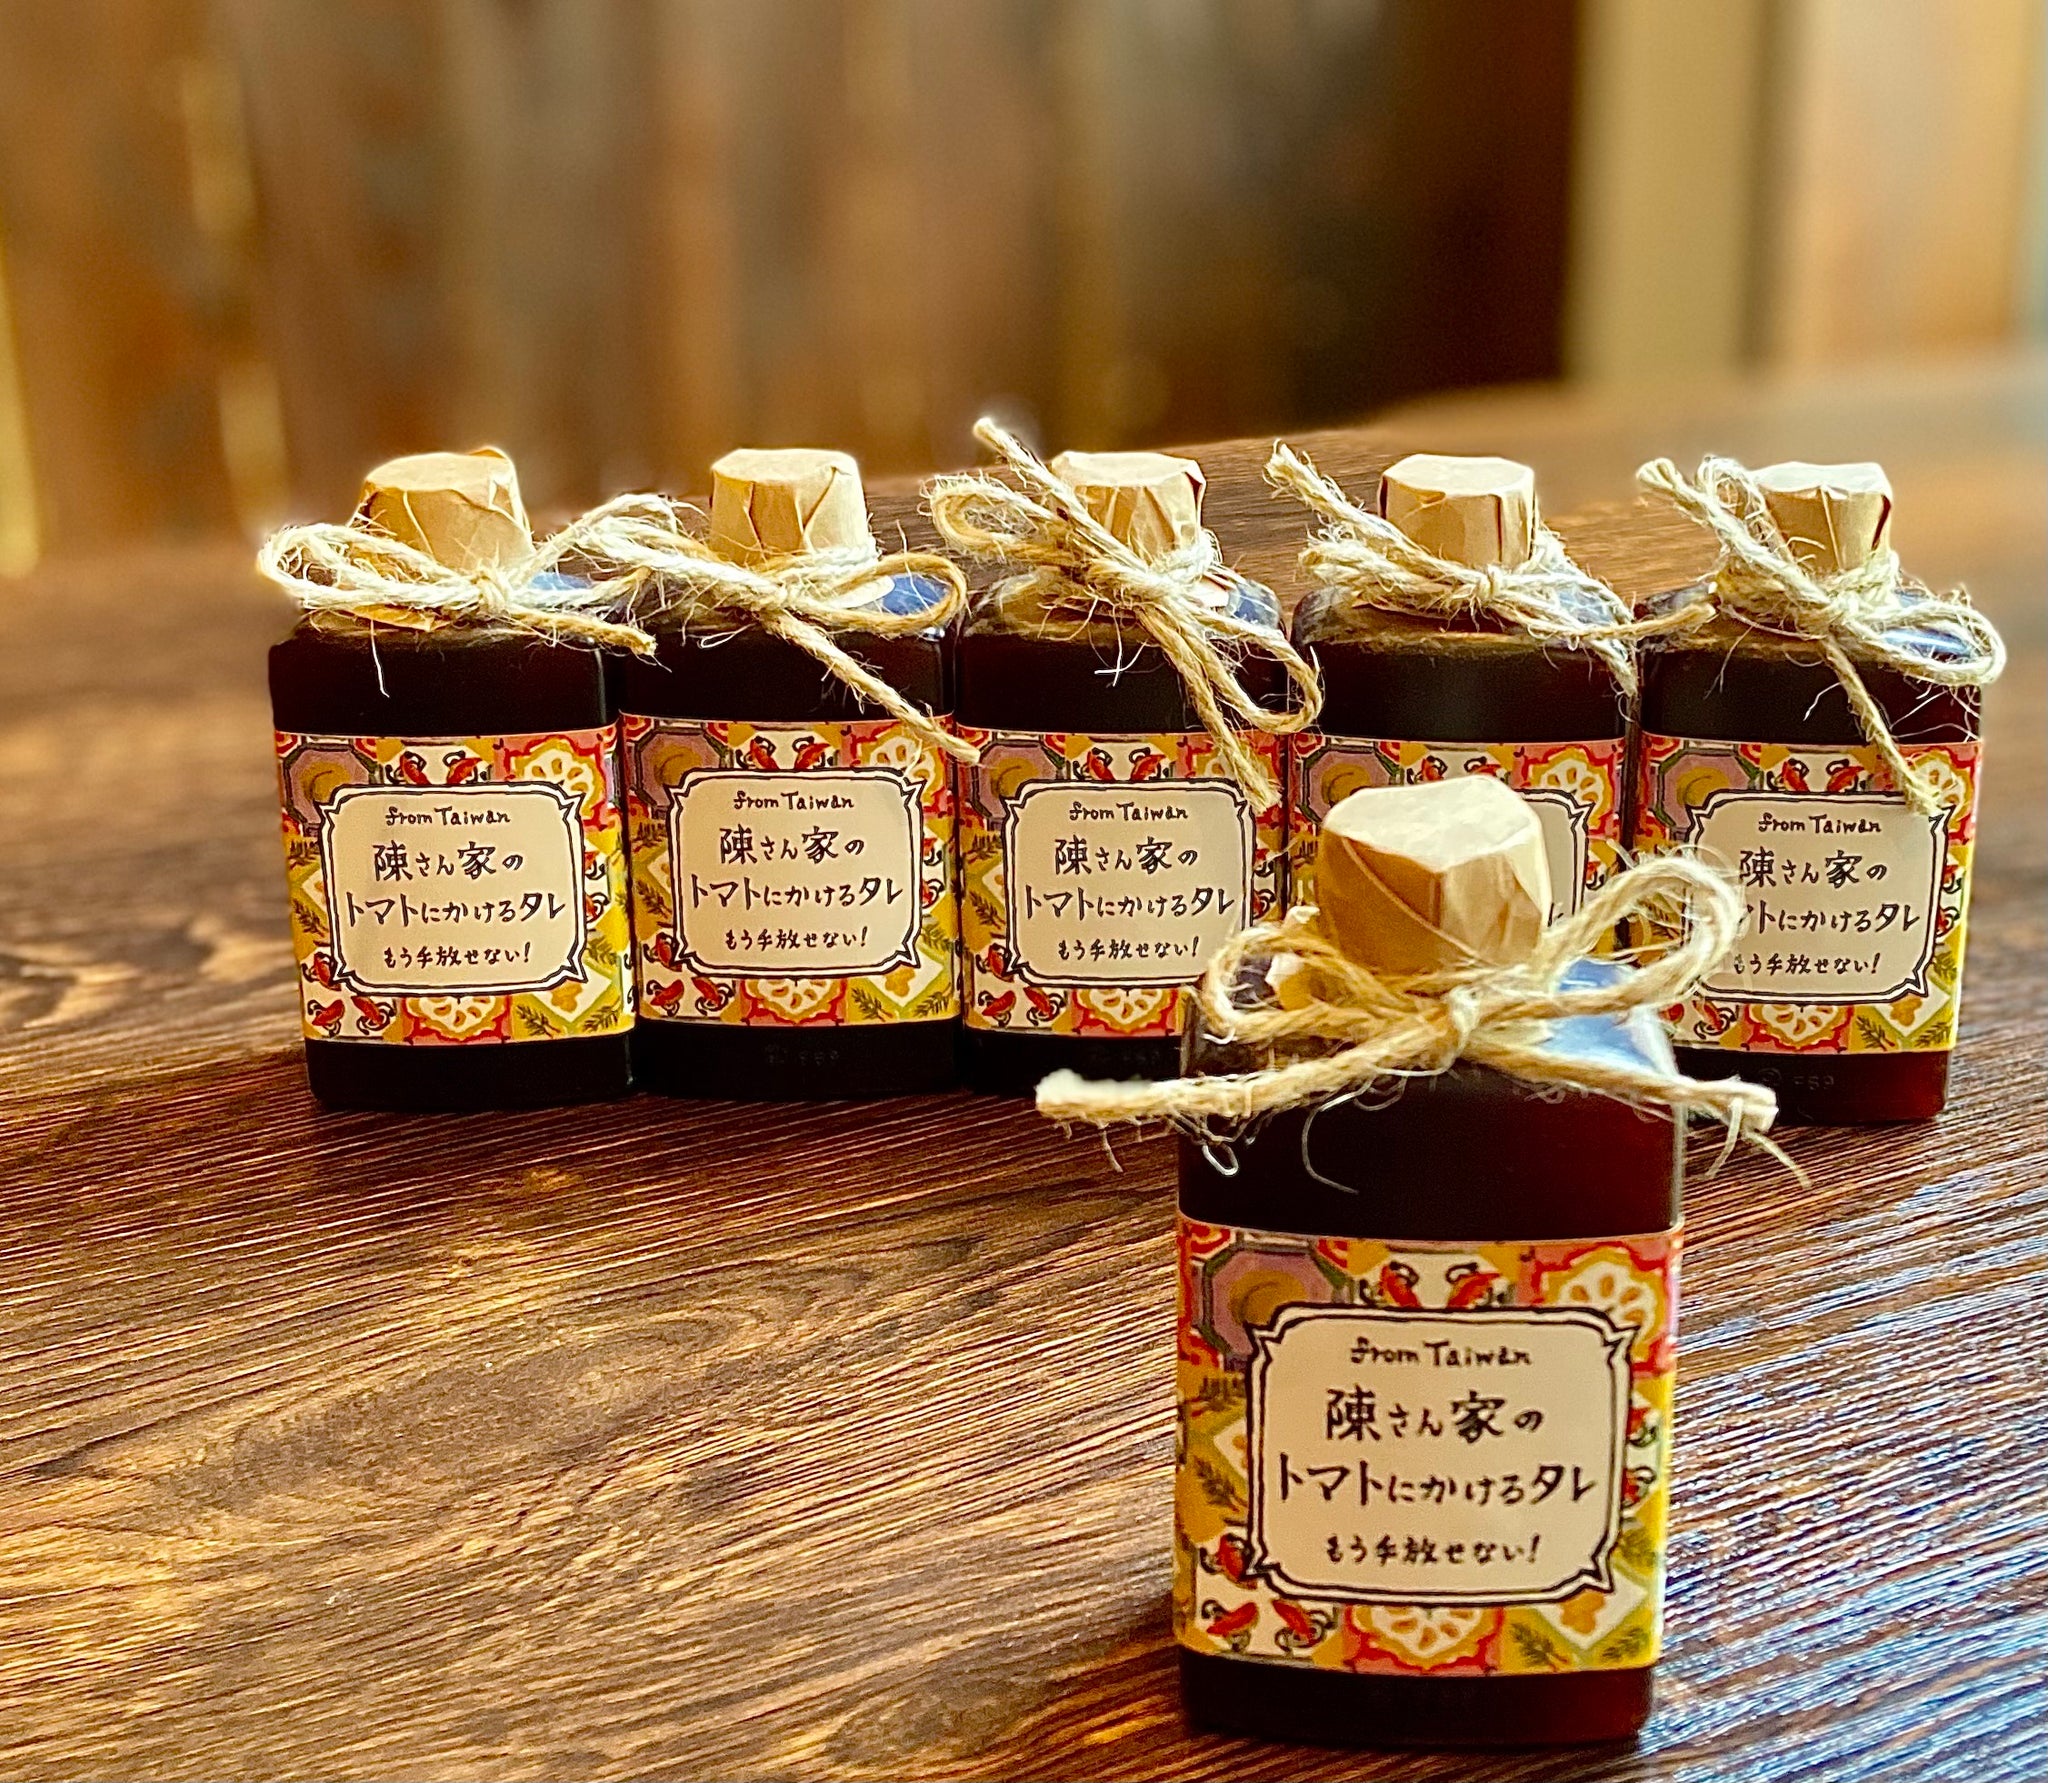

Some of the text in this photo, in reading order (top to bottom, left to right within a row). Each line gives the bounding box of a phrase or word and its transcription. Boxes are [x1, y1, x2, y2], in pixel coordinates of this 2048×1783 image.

[384, 805, 511, 827] from Taiwan
[733, 790, 855, 810] from Taiwan
[1069, 800, 1189, 822] from Taiwan
[1758, 811, 1882, 835] from Taiwan
[372, 839, 524, 882] 陳さん家の
[718, 823, 865, 865] 陳さん家の
[1054, 834, 1198, 876] 陳さん家の
[1738, 845, 1888, 889] 陳さん家の
[346, 891, 566, 928] トマトにかけるタレ
[690, 873, 903, 911] トマトにかけるタレ
[1025, 884, 1235, 922] トマトにかけるタレ
[1739, 899, 1921, 935] トにかけるタレ
[383, 941, 531, 970] もう手放せない!
[725, 925, 868, 952] もう手放せない!
[1058, 935, 1200, 962] もう手放せない!
[1350, 1335, 1532, 1367] from Taiwan
[1325, 1382, 1544, 1445] 陳さん家の
[1279, 1451, 1596, 1507] トマトにかけるタレ
[1326, 1534, 1541, 1568] もう手放せない!
